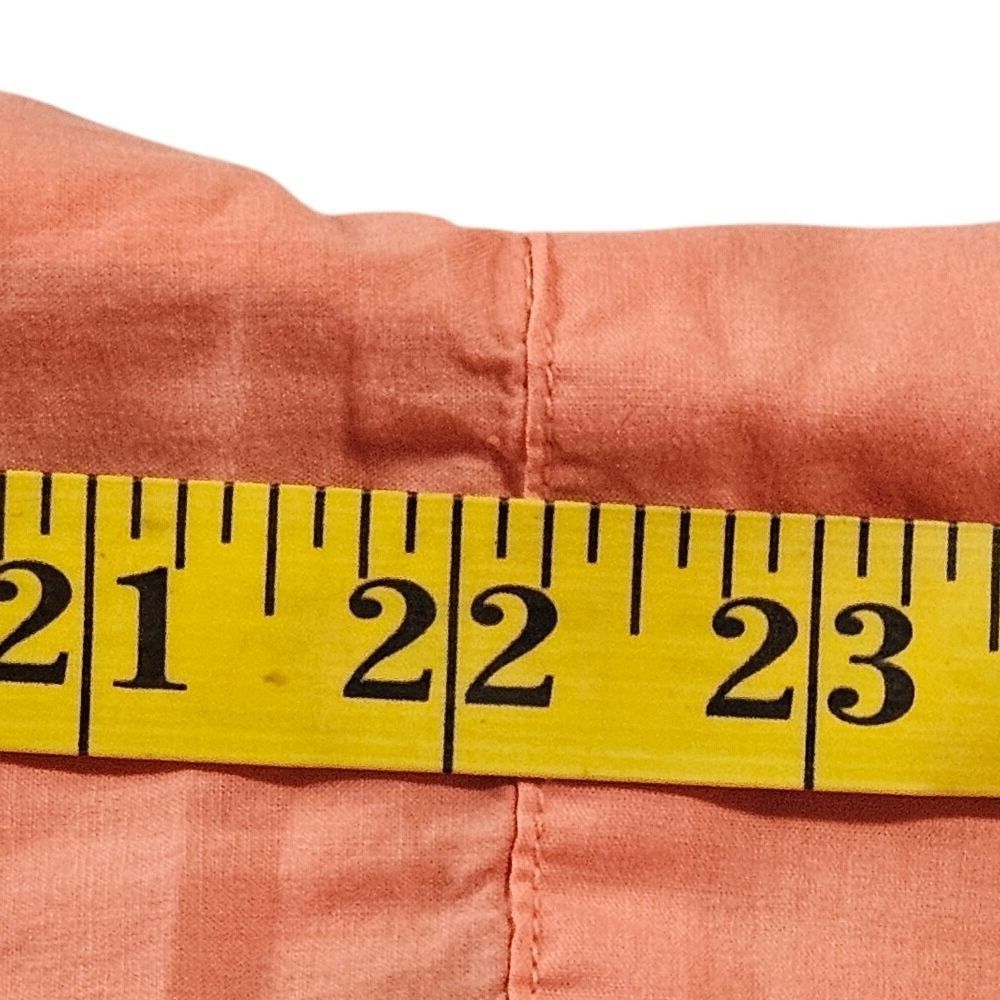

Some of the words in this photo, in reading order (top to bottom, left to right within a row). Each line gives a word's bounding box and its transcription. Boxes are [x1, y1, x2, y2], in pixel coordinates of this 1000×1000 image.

[0, 560, 187, 691] 21
[343, 578, 558, 708] 22
[706, 597, 915, 726] 23
